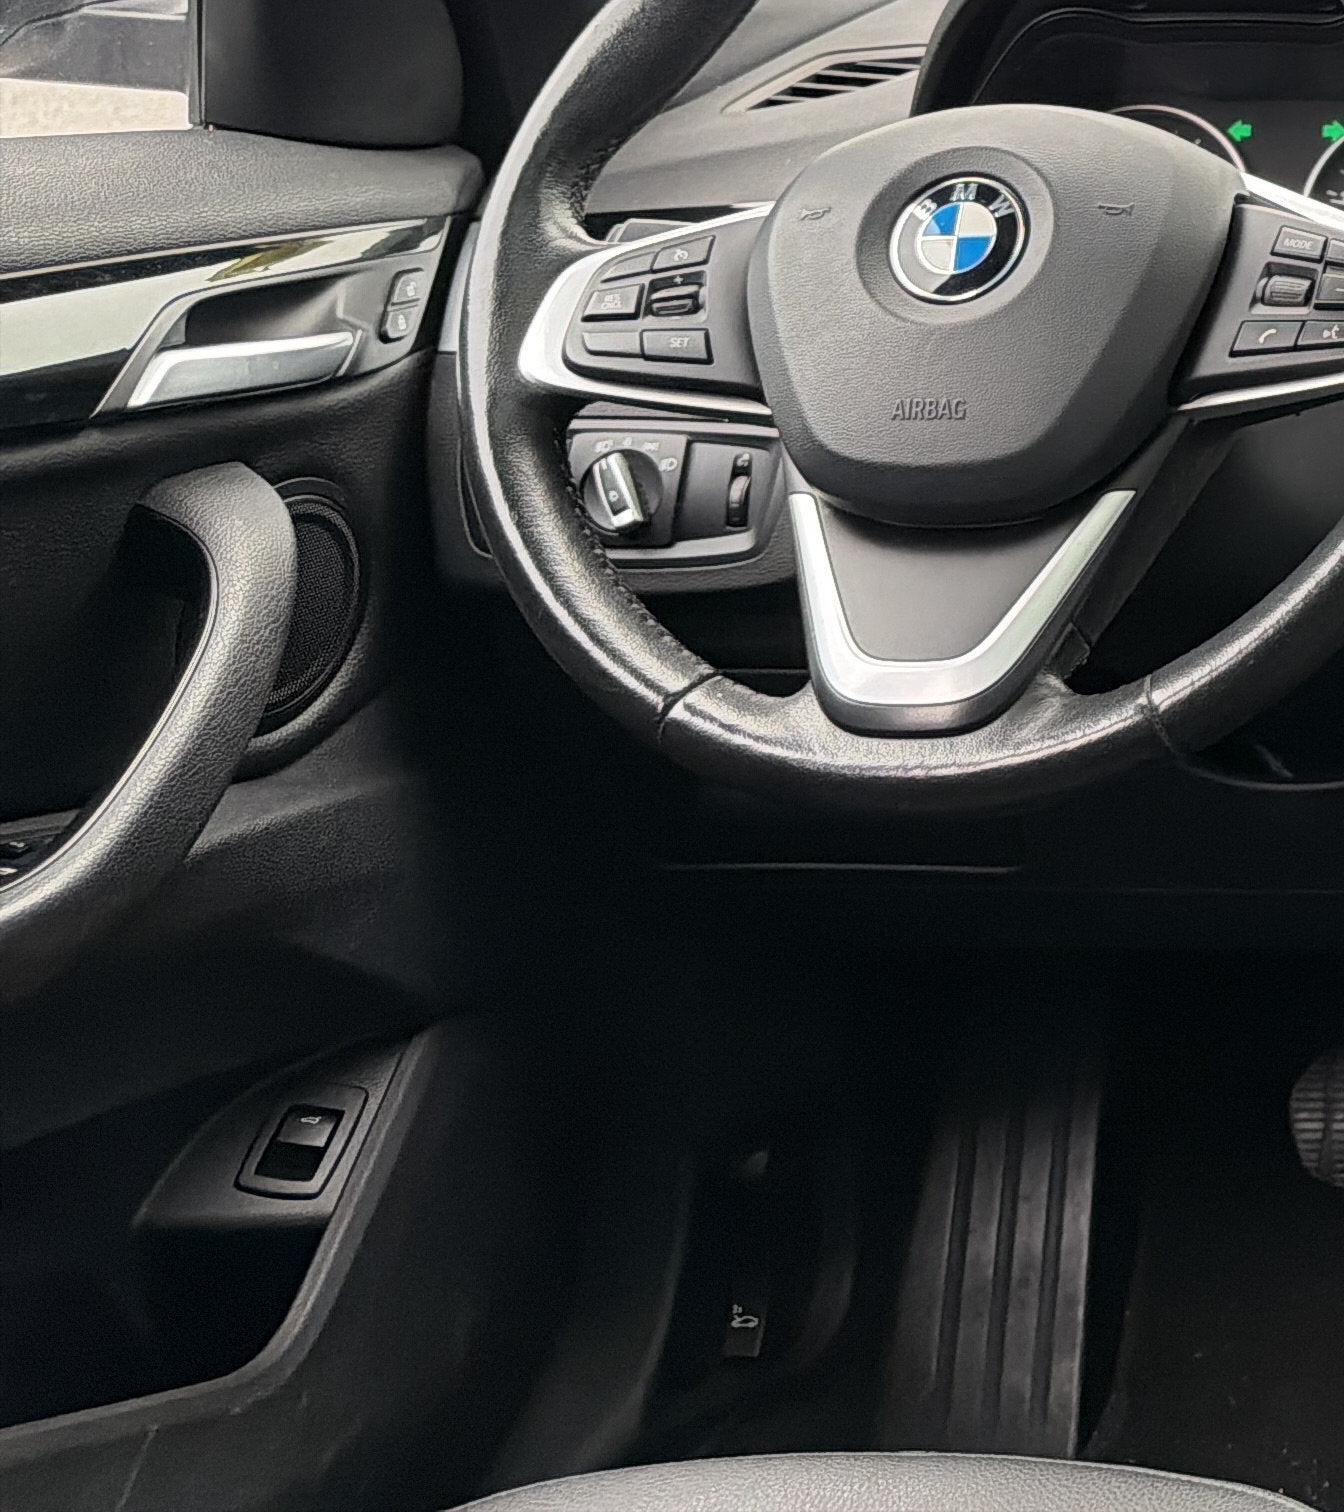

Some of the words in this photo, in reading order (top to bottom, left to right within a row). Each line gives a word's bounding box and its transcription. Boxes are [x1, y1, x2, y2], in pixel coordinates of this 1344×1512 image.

[912, 182, 1017, 221] BMW
[1283, 237, 1314, 250] MODE
[669, 336, 691, 348] SET
[891, 397, 967, 421] AIRBAG
